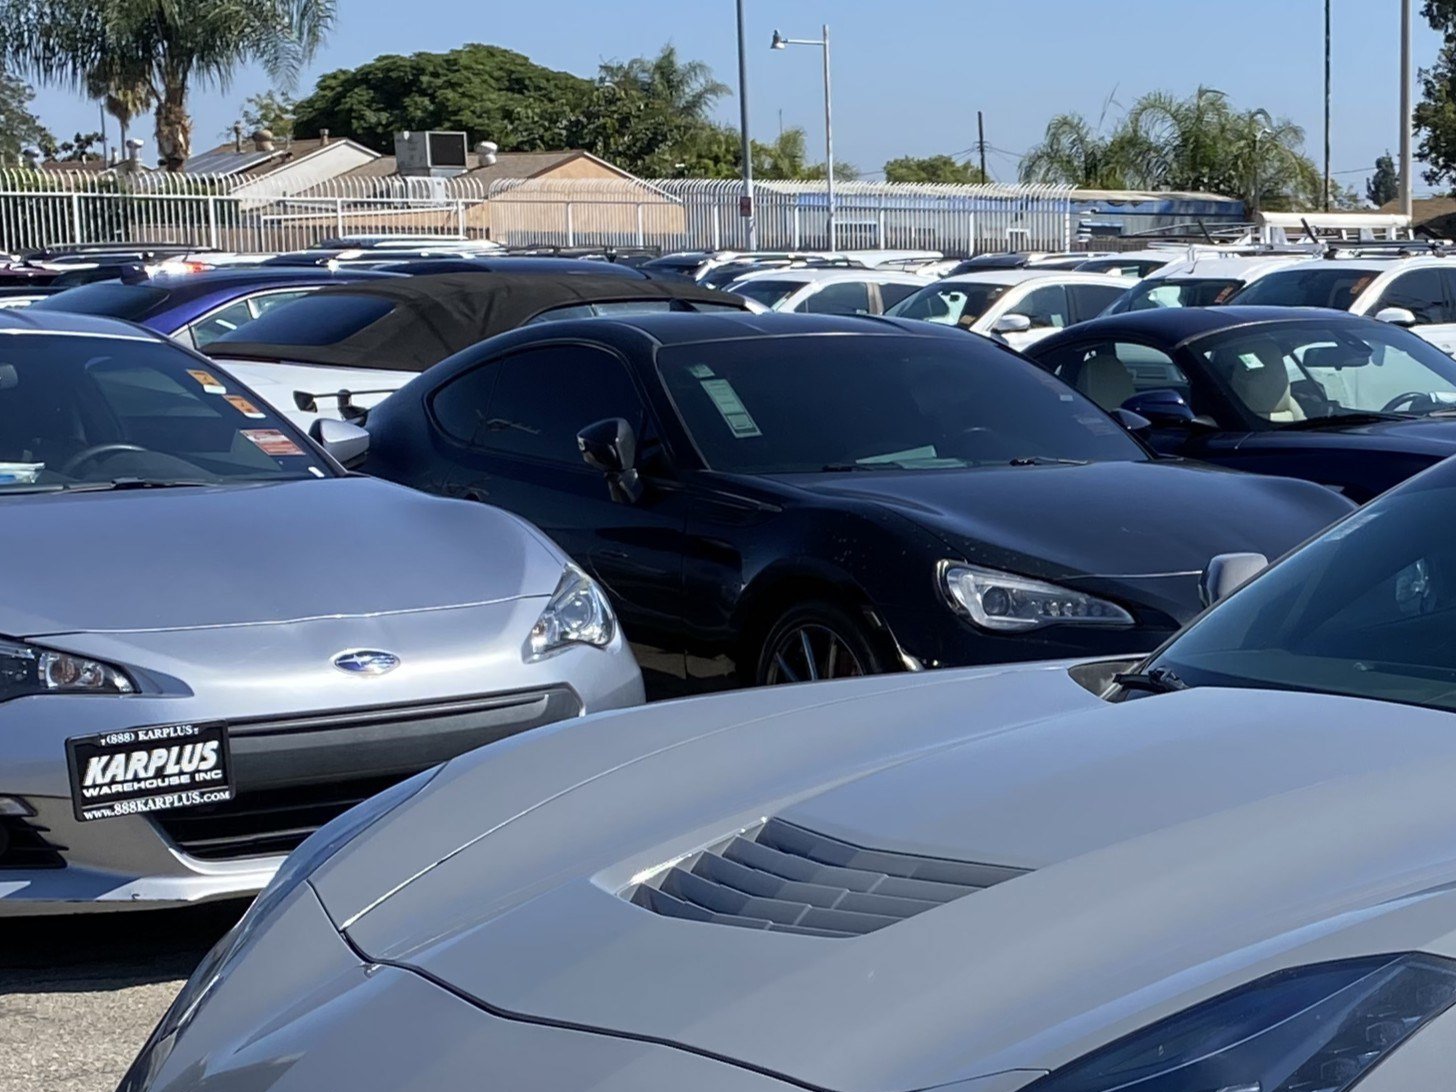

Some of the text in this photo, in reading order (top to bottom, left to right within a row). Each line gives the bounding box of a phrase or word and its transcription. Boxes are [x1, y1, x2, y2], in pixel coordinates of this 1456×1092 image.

[106, 725, 193, 746] (888) KARPLUS
[82, 740, 220, 787] KARPLUS
[82, 769, 223, 798] WAREHOUSE INC
